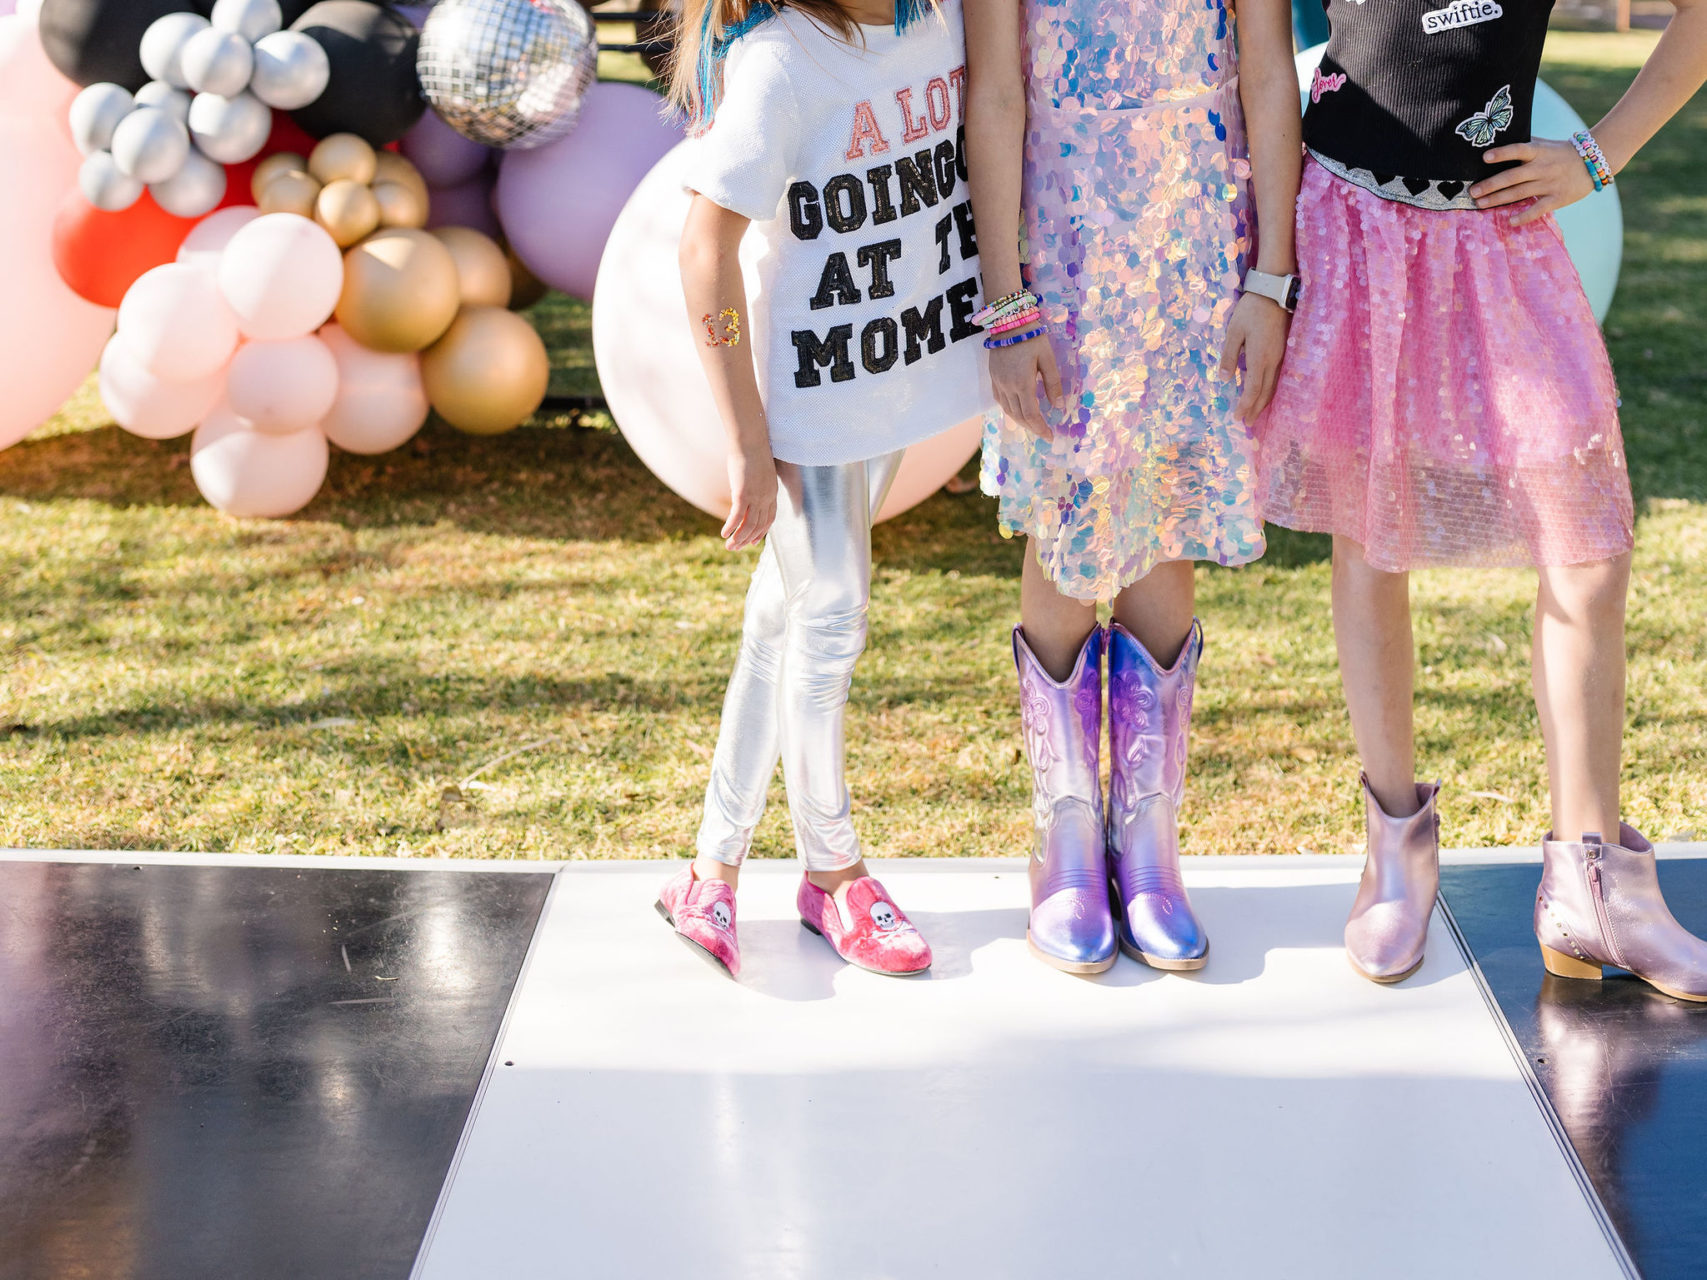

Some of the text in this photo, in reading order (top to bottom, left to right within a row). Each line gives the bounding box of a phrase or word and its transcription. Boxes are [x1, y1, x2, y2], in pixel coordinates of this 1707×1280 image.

[1427, 1, 1499, 29] swiftie.
[845, 99, 889, 161] A
[895, 66, 966, 144] LOT
[786, 138, 957, 241] GOING
[809, 237, 902, 311] AT
[790, 274, 986, 389] MOME
